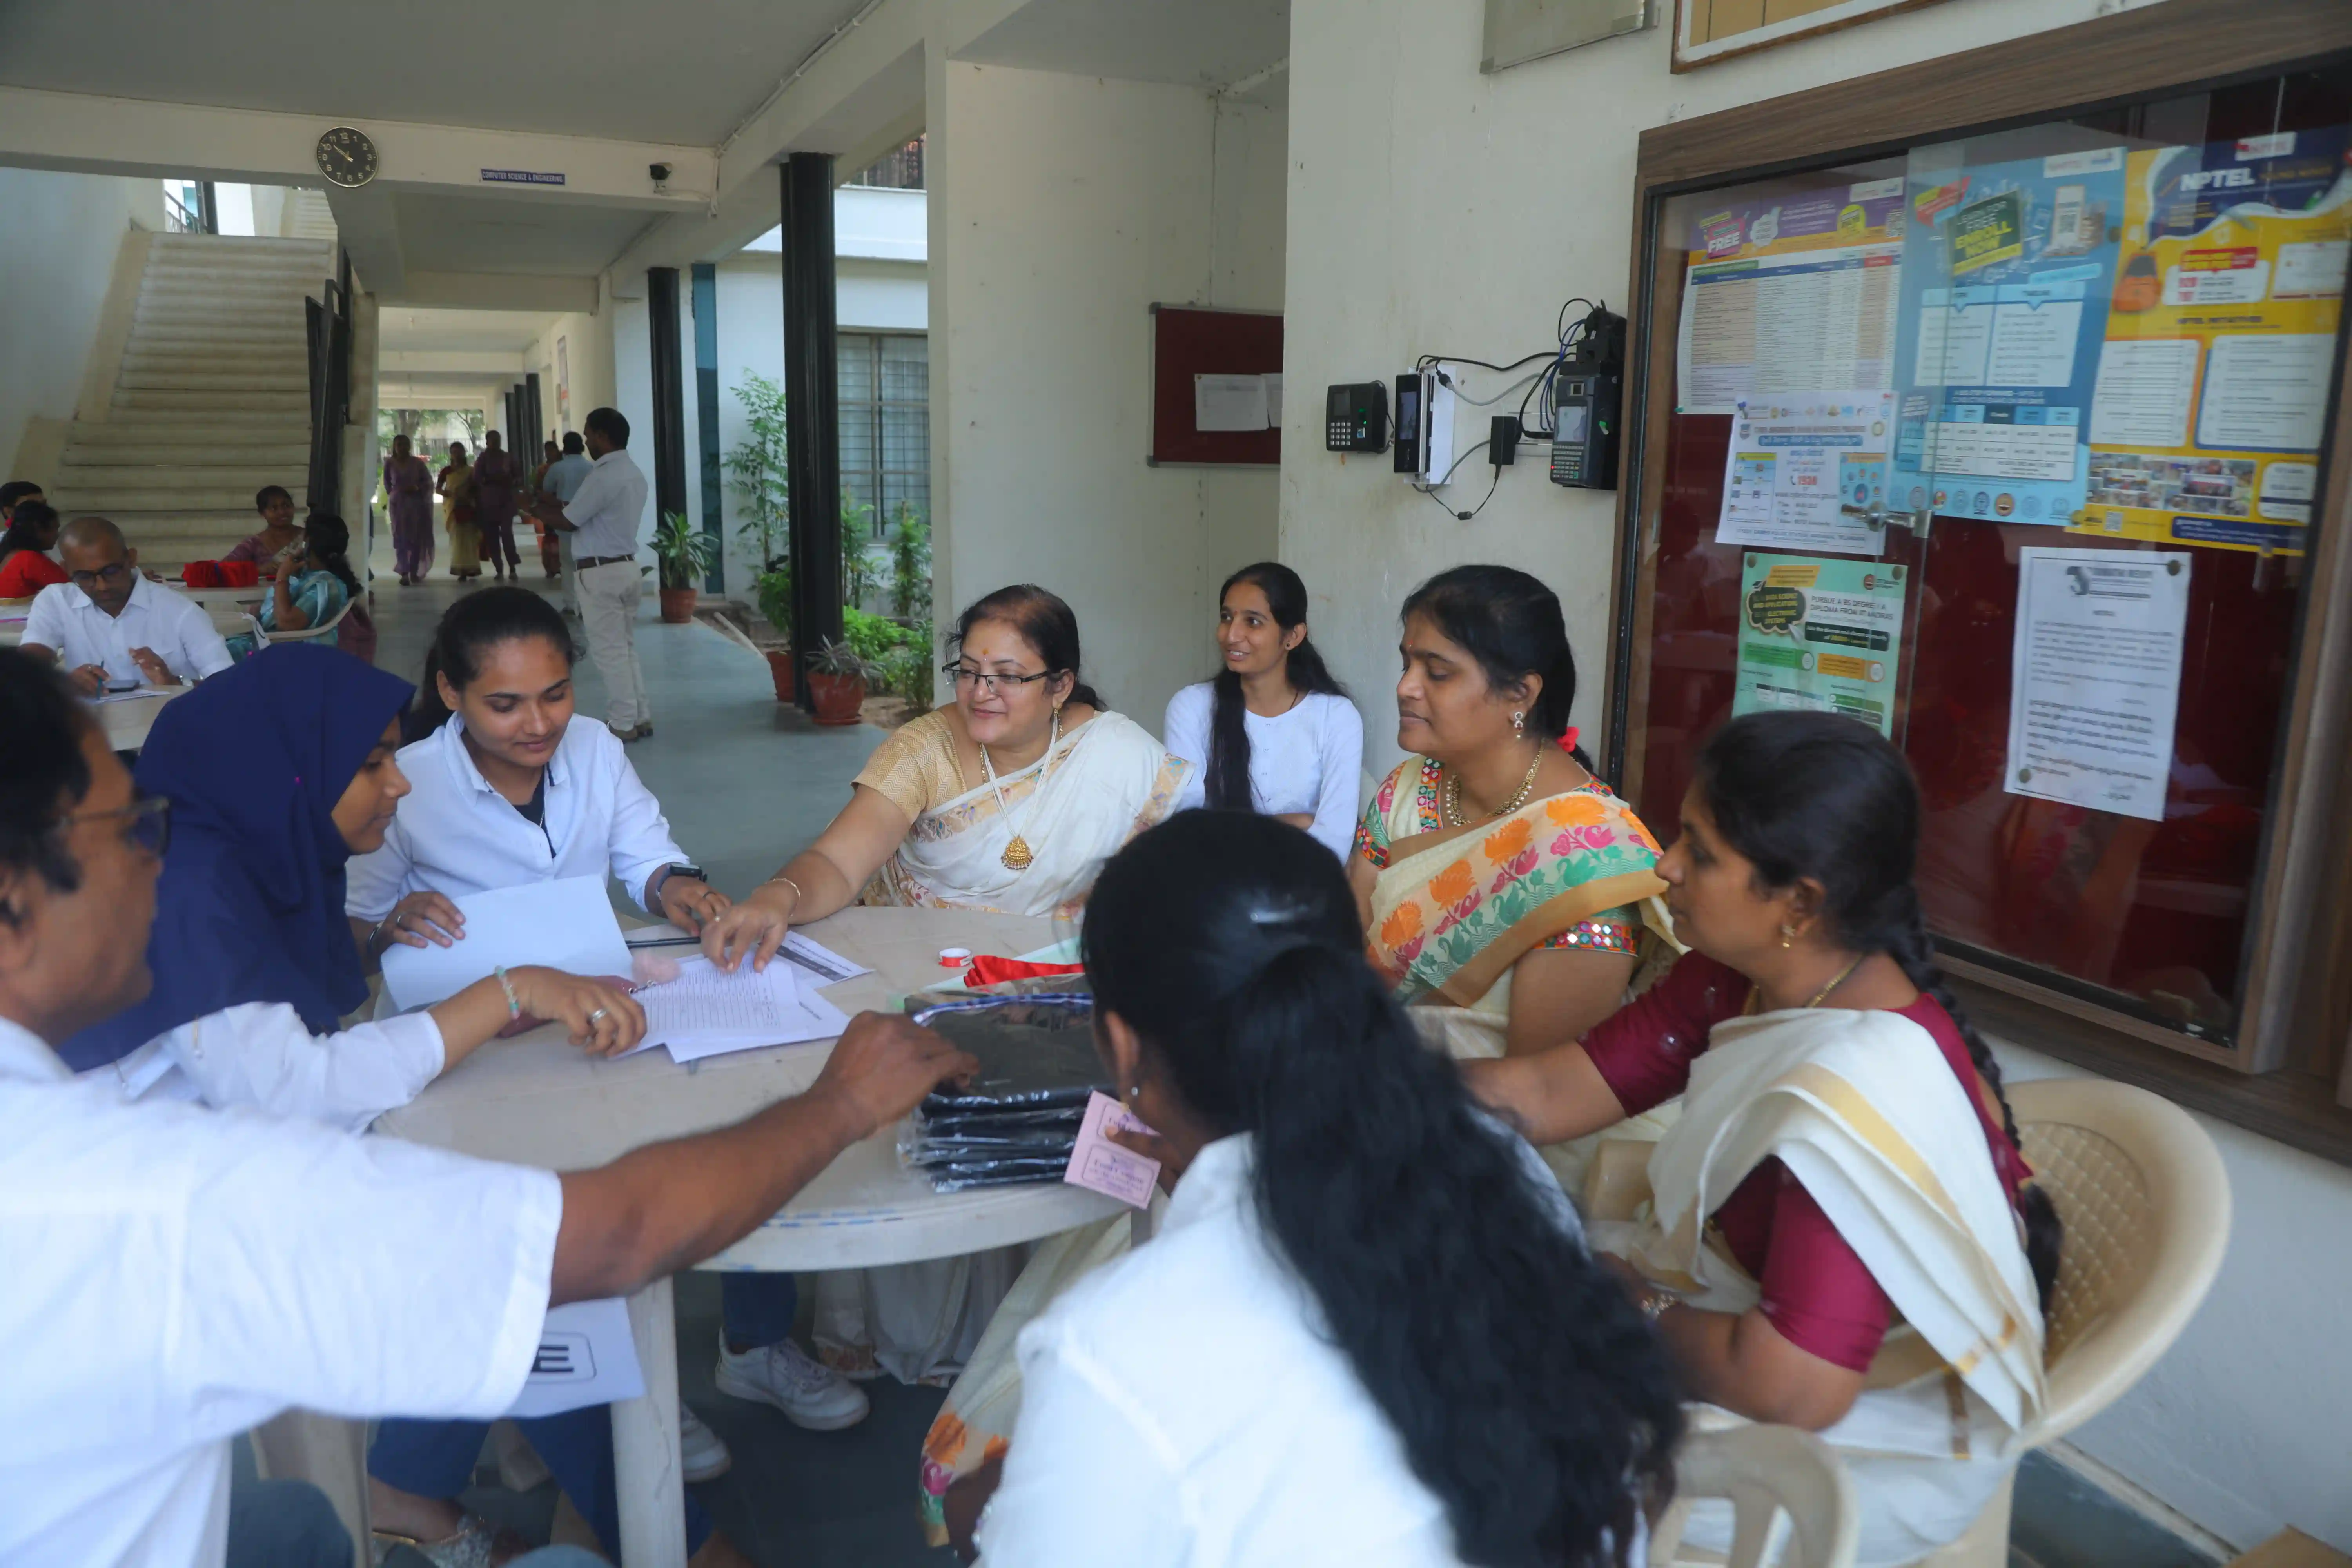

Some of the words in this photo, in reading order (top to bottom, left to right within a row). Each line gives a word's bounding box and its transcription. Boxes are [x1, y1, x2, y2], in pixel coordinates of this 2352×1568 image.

[482, 171, 507, 180] COMPUTER
[533, 174, 563, 183] ENGINEERING
[2180, 167, 2255, 192] NPTEL
[1986, 201, 2007, 212] FOR
[1965, 213, 1998, 234] FREE
[1708, 232, 1741, 253] FREE
[1955, 221, 2014, 249] ENROLL
[1965, 236, 2001, 259] NOW
[1811, 595, 1836, 604] PURSUE
[1810, 604, 1838, 613] DIPLOMA
[1868, 611, 1894, 620] MADRAS
